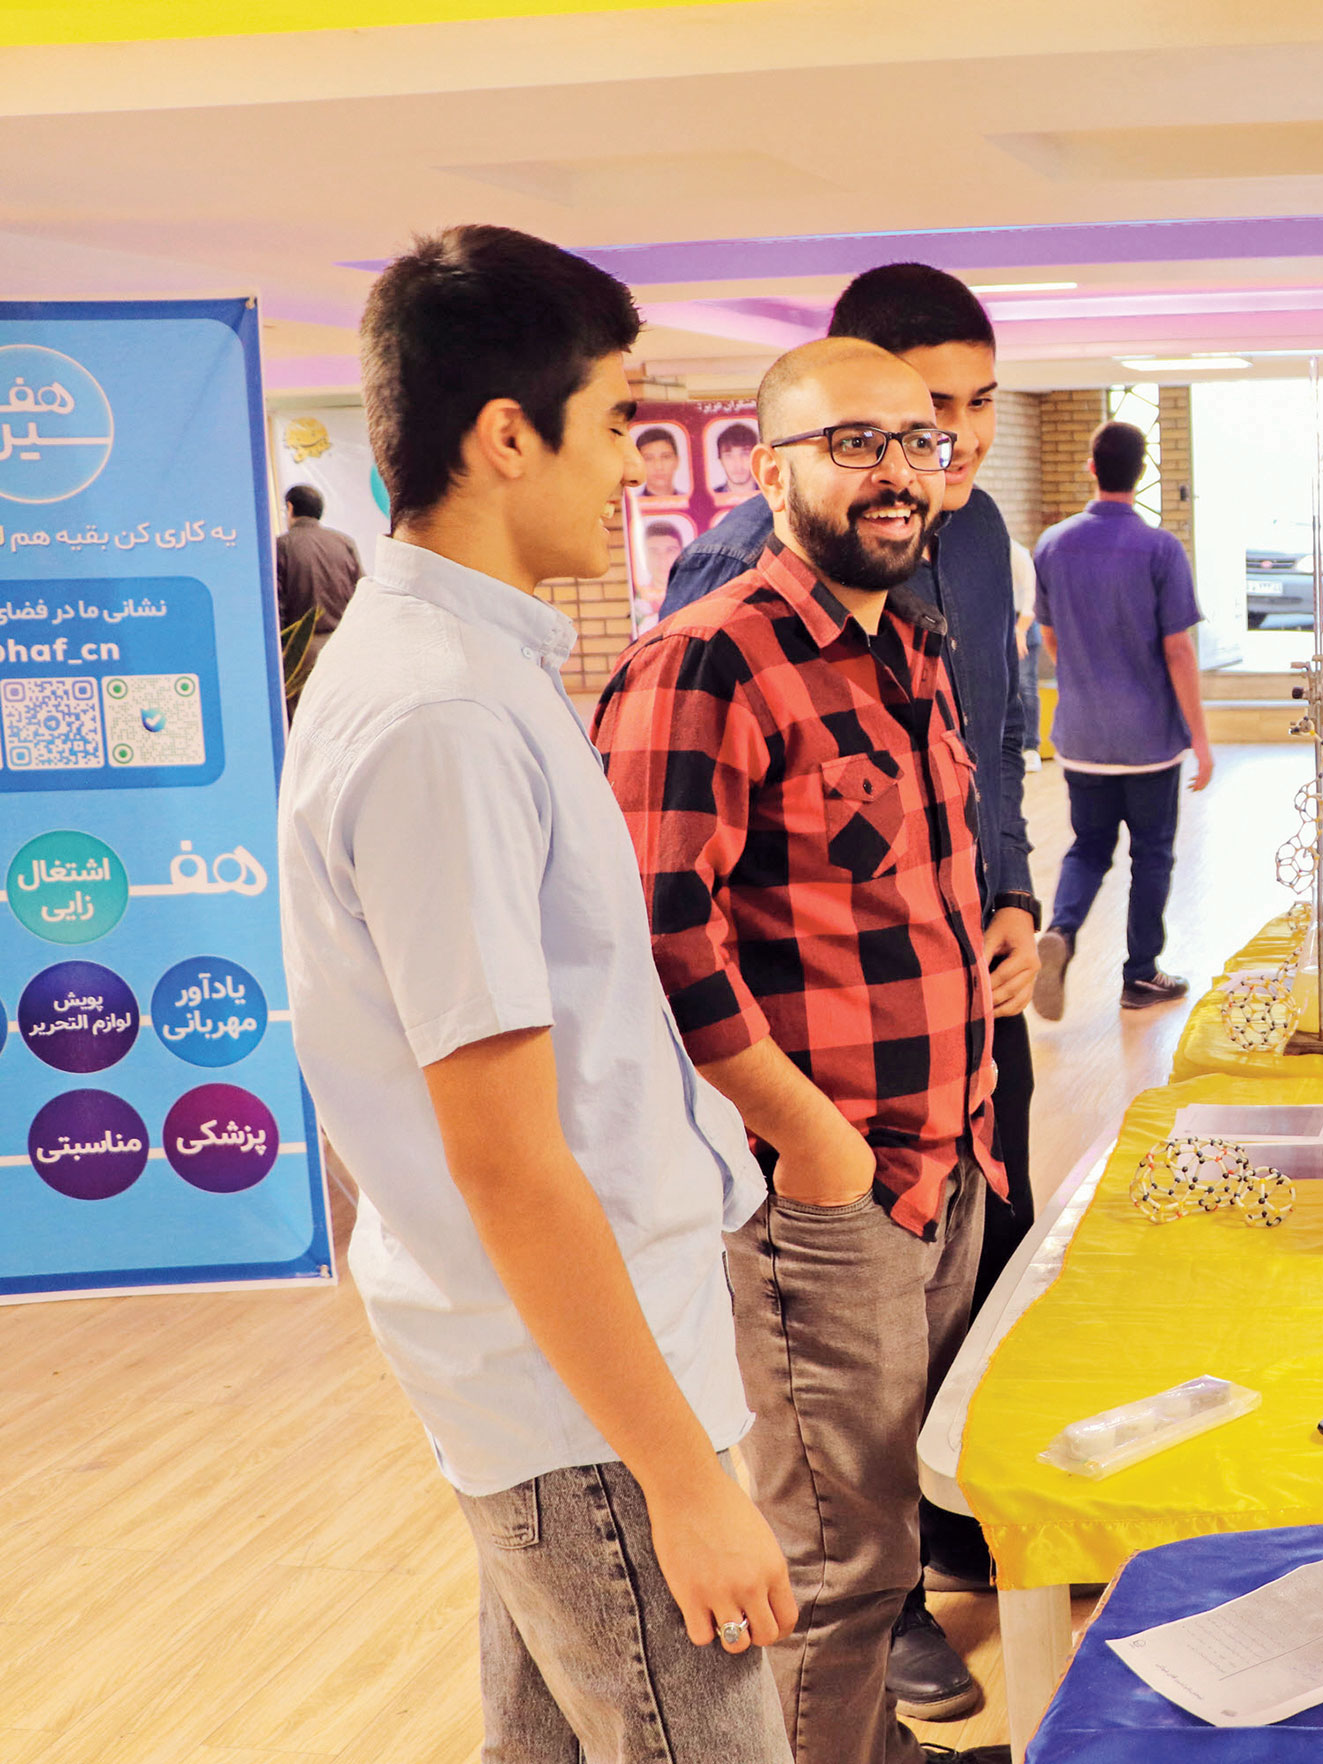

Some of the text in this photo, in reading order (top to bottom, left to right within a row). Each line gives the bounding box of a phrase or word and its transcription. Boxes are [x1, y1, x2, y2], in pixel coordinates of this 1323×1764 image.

[10, 530, 51, 552] هم
[55, 525, 110, 551] بقیه
[114, 522, 151, 550] کن
[155, 520, 206, 549] کاری
[210, 525, 238, 548] یه
[52, 603, 76, 624] در
[78, 600, 99, 619] ما
[103, 598, 168, 624] نشانی
[0, 637, 120, 665] haf_cn
[17, 857, 112, 891] اشتغال
[41, 890, 95, 922] زایی
[53, 991, 104, 1013] پویش
[175, 972, 246, 1007] یادآور
[28, 1012, 132, 1037] لوازم التحریر
[162, 1010, 258, 1040] مهربانی
[36, 1130, 143, 1164] مناسبتی
[176, 1119, 267, 1156] پزشکی
